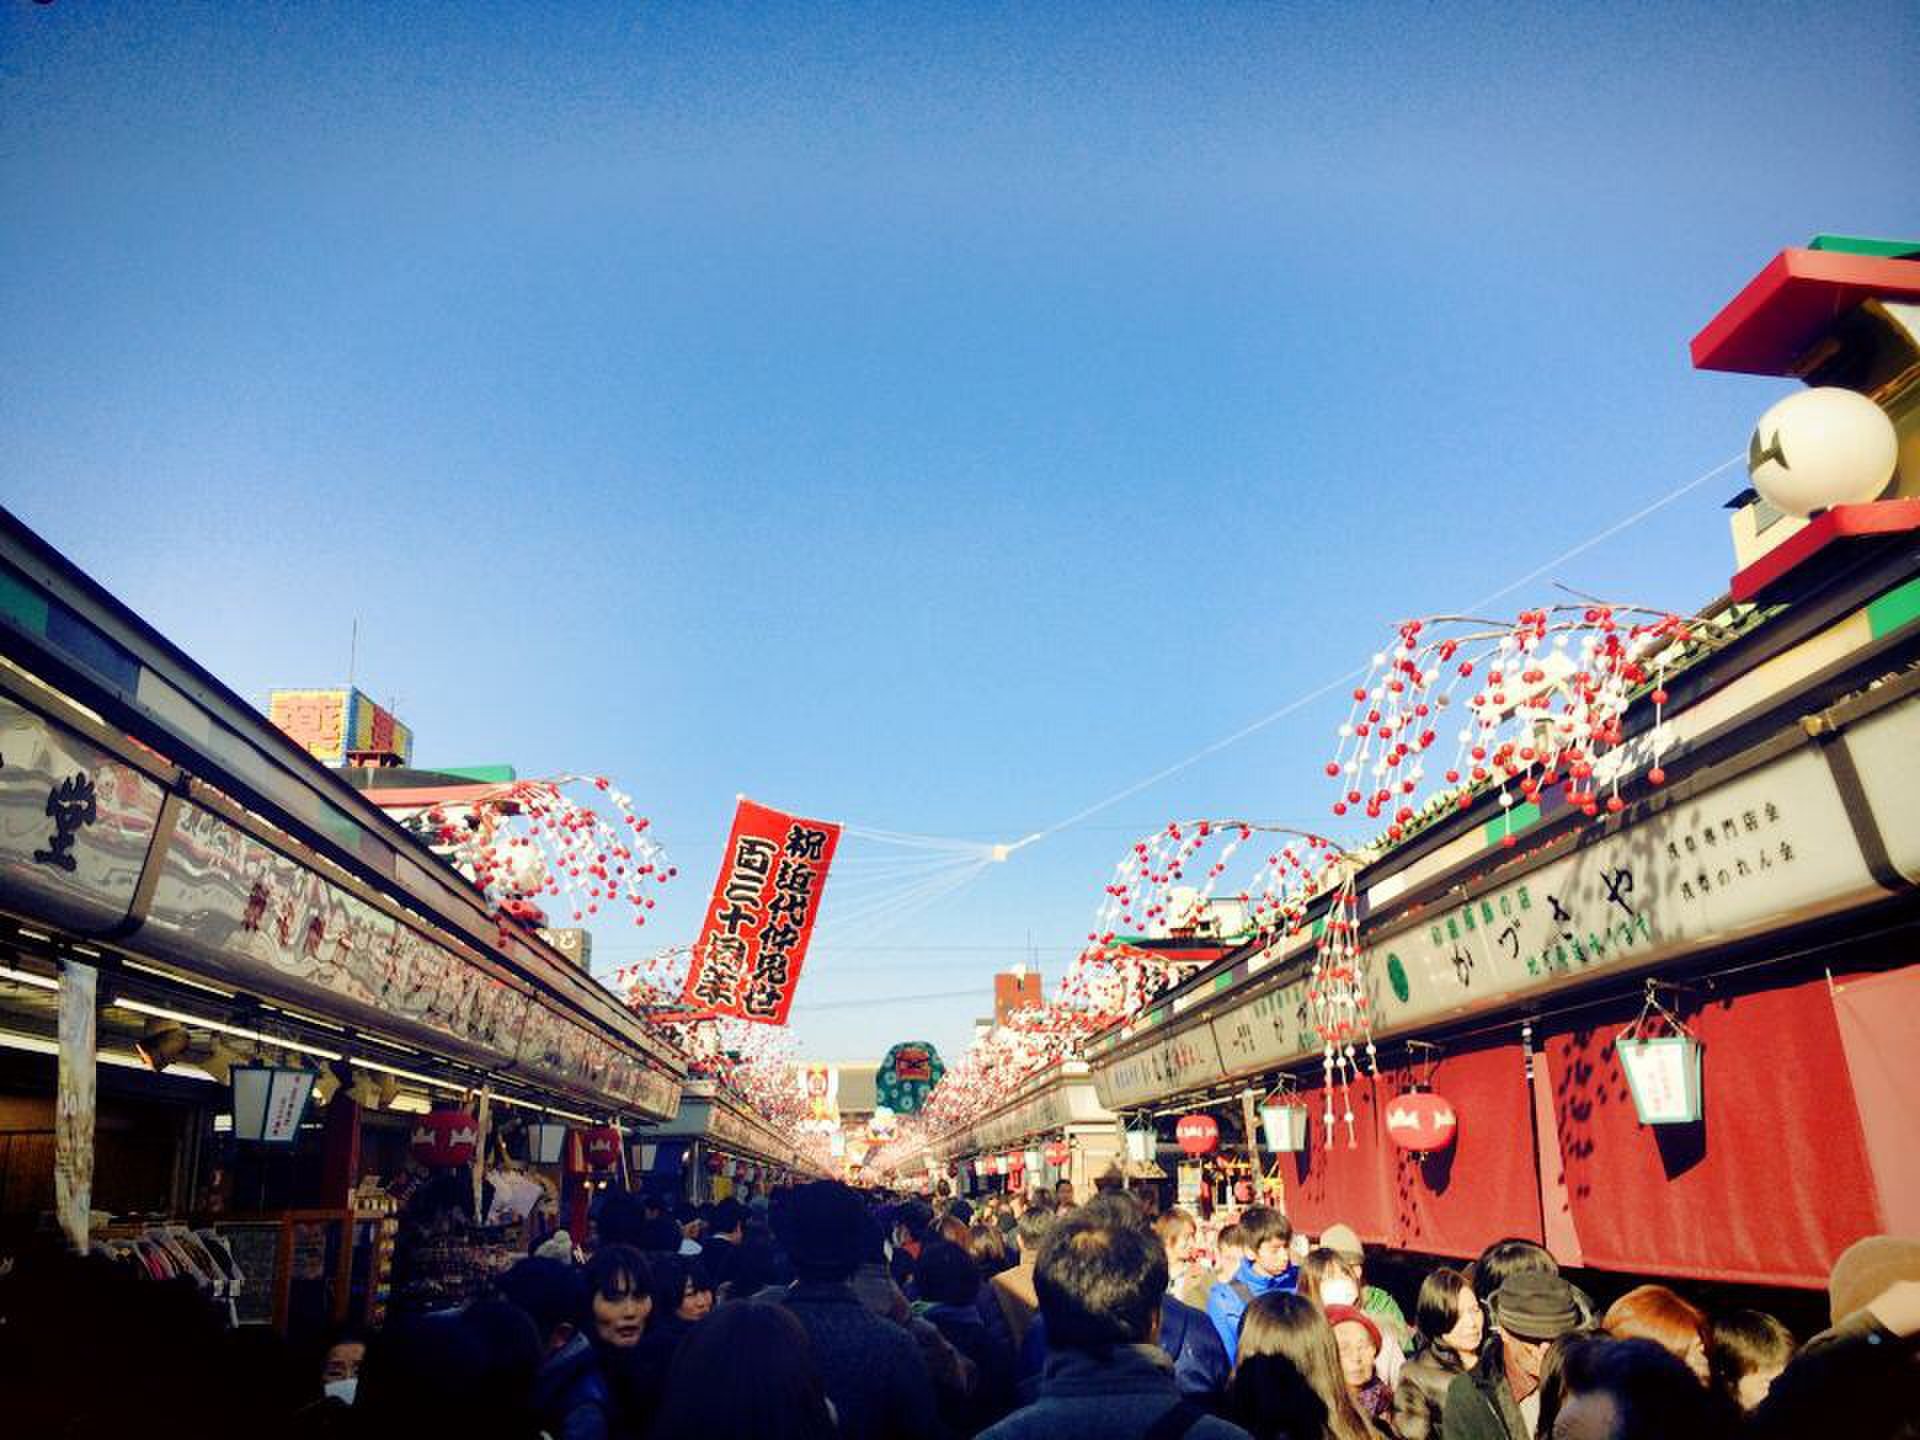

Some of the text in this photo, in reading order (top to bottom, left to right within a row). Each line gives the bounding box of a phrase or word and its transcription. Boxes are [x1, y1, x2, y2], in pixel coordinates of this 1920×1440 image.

[693, 835, 779, 1005] 百三十周年
[743, 823, 828, 1017] 祝近代仲見世
